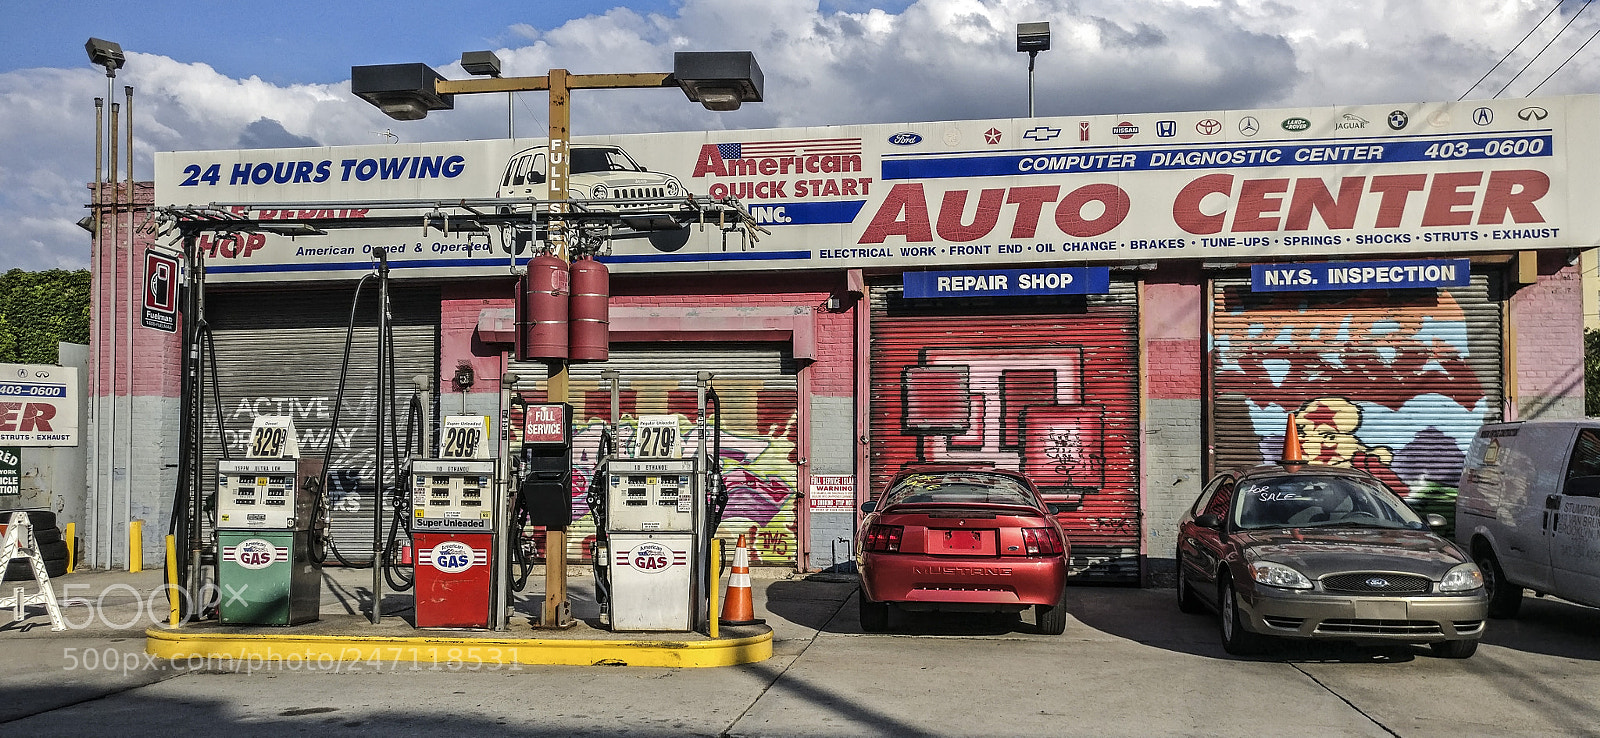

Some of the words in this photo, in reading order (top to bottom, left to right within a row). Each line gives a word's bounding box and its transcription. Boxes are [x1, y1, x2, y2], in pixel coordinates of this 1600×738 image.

[1335, 122, 1365, 131] JAGUAR
[893, 133, 916, 144] Ford
[692, 144, 862, 178] American
[1018, 154, 1137, 172] COMPUTER
[1150, 149, 1282, 167] DIAGNOSTIC
[1294, 145, 1384, 163] CENTER
[1424, 138, 1545, 160] 403-0600
[179, 165, 220, 186] 24
[229, 160, 333, 185] HOURS
[340, 155, 465, 182] TOWING
[708, 181, 787, 200] QUICK
[794, 178, 872, 198] START
[751, 206, 792, 223] INC.
[857, 182, 1132, 244] AUTO
[1172, 169, 1550, 235] CENTER
[180, 233, 266, 259] HOP
[295, 247, 355, 257] American
[362, 243, 406, 253] Oned
[414, 243, 423, 252] &
[431, 241, 490, 254] Operated
[819, 248, 894, 259] ELECTRICAL
[900, 246, 937, 257] WORK
[949, 245, 992, 256] FRONT
[998, 244, 1023, 254] END
[1035, 243, 1056, 253] OIL
[1062, 241, 1117, 252] CHANGE
[1130, 239, 1185, 250] BRAKES
[1201, 237, 1270, 248] TUNE-UPS
[1283, 235, 1342, 246] SPRINGS
[1355, 233, 1412, 245] SHOCKS
[1423, 231, 1479, 243] STRUTS
[1492, 228, 1560, 240] EXHAUST
[937, 276, 1008, 292] REPAIR
[1018, 273, 1074, 291] SHOP
[1264, 269, 1318, 286] N.Y.S.
[1327, 265, 1455, 284] INSPECTION
[146, 311, 173, 322] Fuelman
[233, 396, 330, 419] ACTIVE
[535, 411, 555, 422] FULL
[527, 423, 561, 435] SERVICE
[224, 428, 358, 450] DRWAY
[1259, 492, 1297, 502] SALE
[417, 519, 442, 528] Super
[443, 519, 484, 528] Unleaded
[640, 542, 663, 550] American
[240, 552, 271, 565] GAS
[437, 555, 469, 568] GAS
[635, 556, 668, 569] GAS
[912, 566, 1013, 576] MUSTANG
